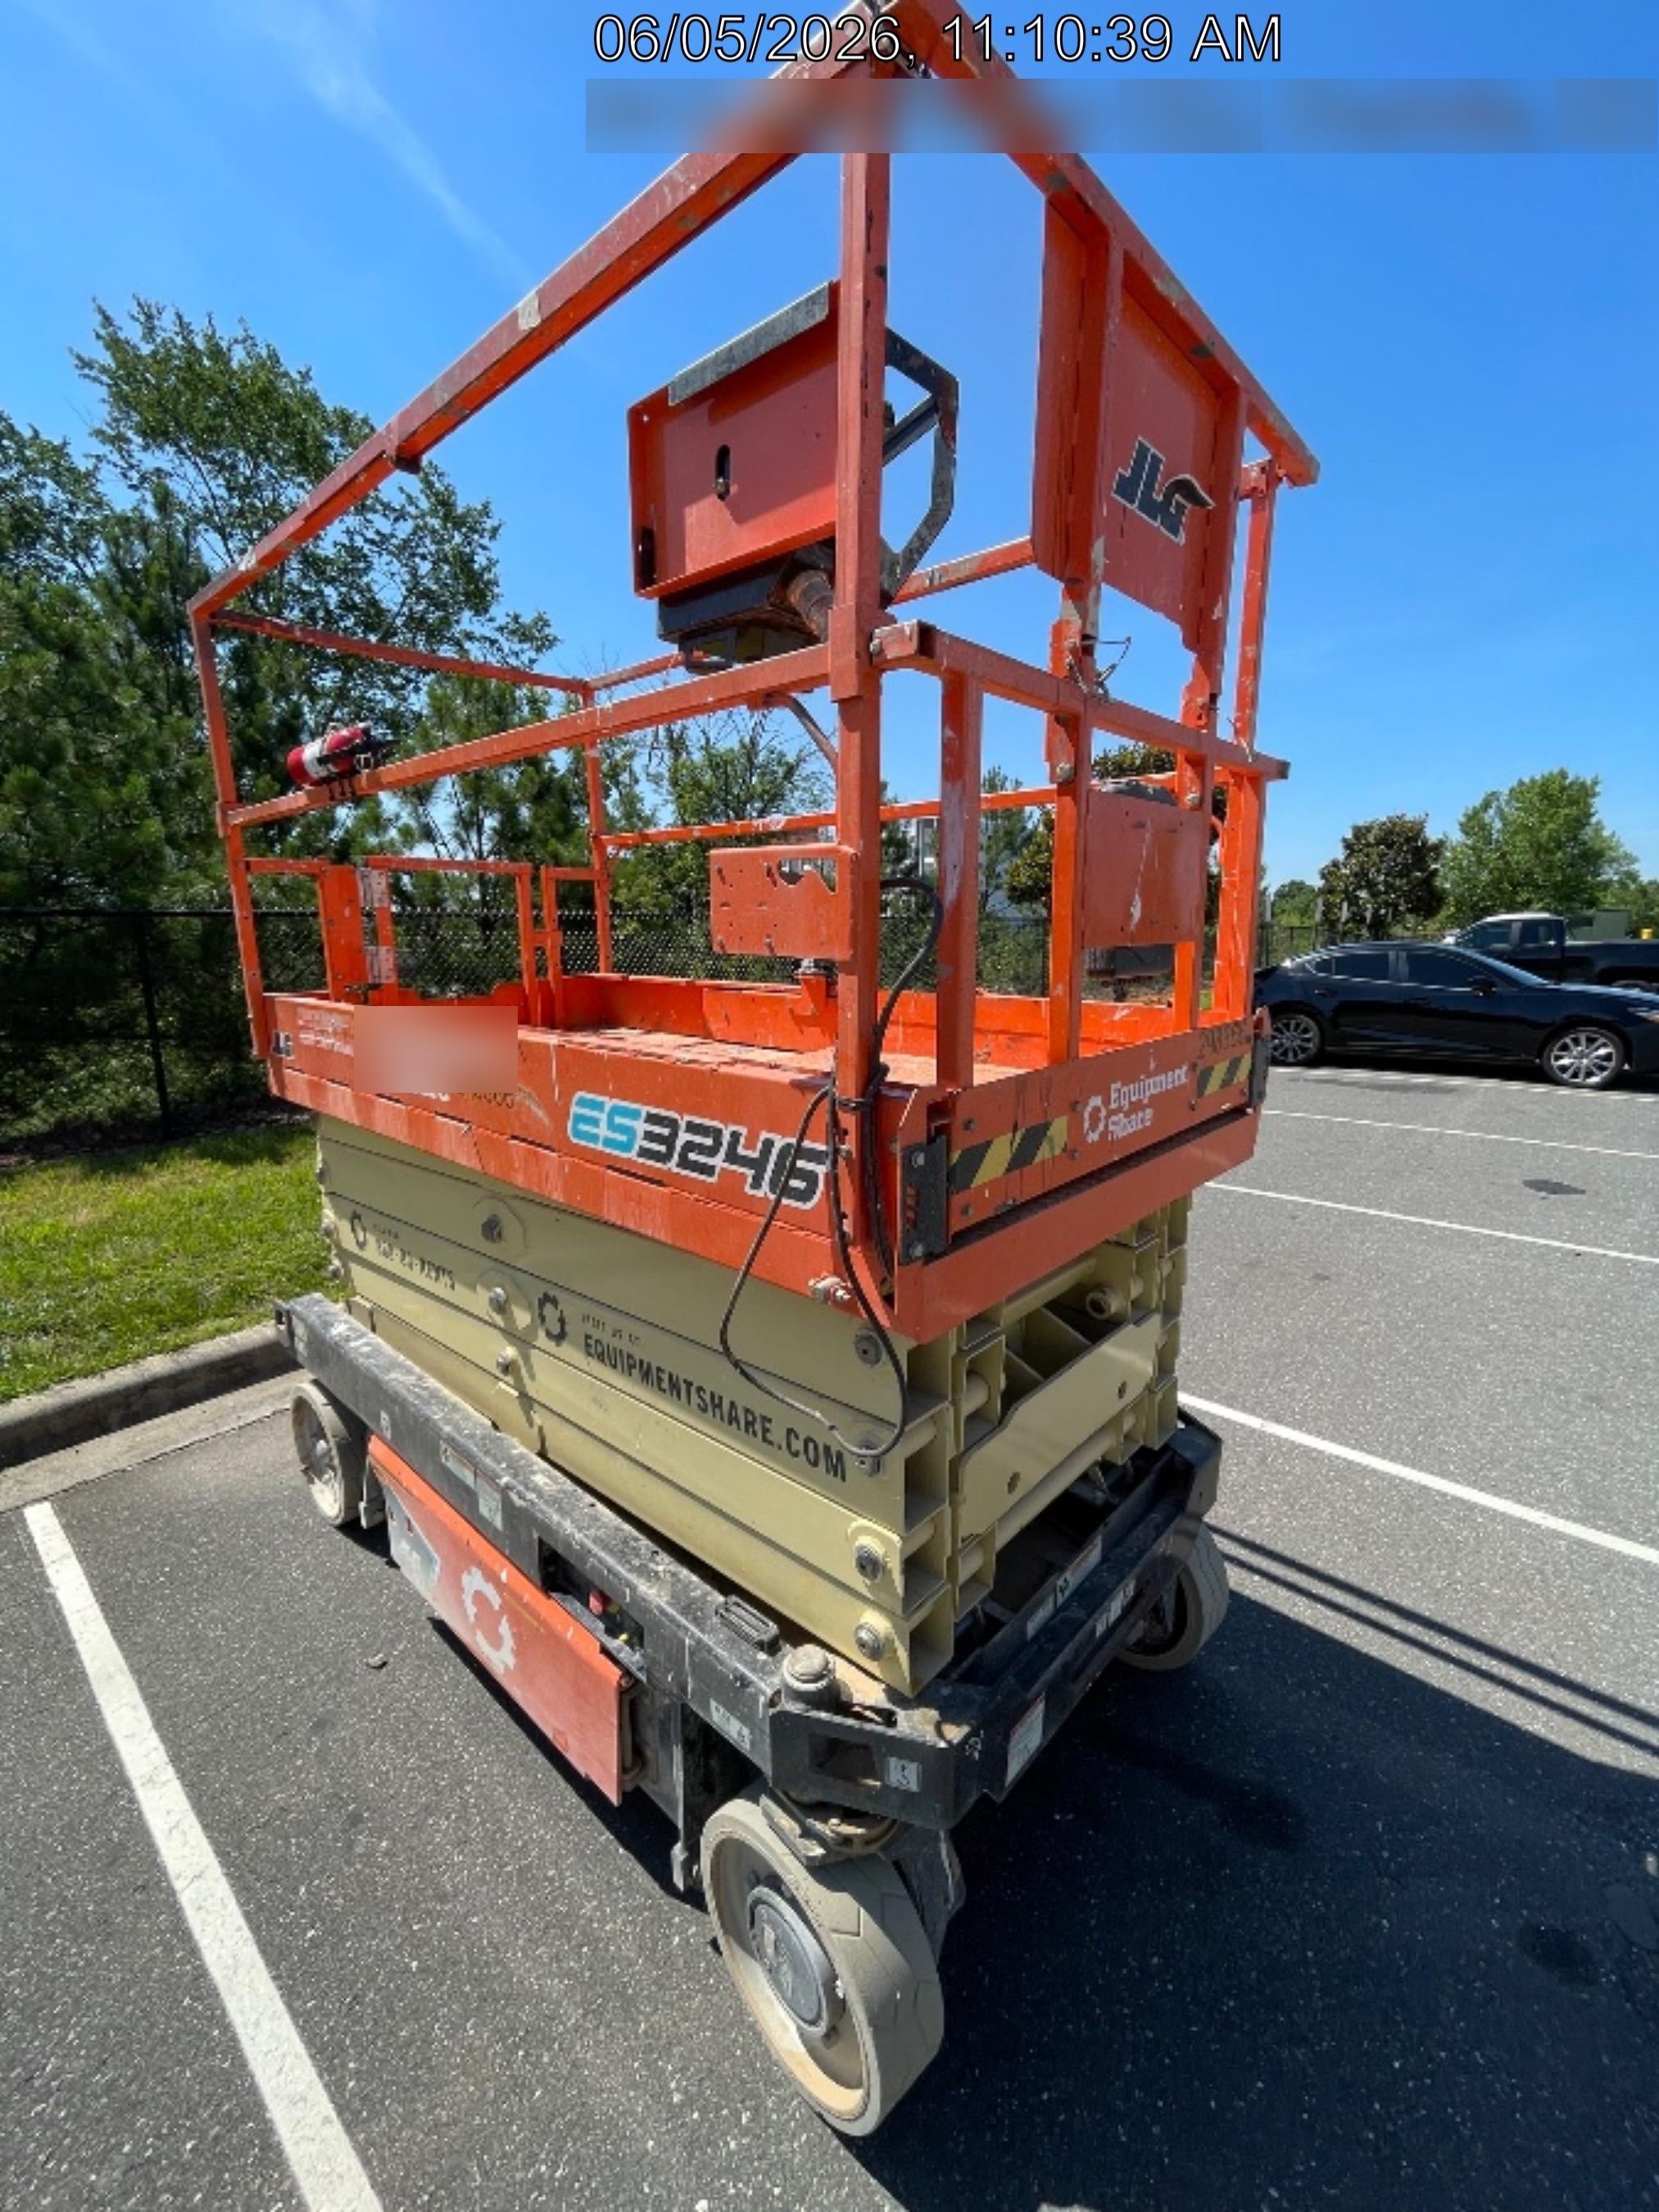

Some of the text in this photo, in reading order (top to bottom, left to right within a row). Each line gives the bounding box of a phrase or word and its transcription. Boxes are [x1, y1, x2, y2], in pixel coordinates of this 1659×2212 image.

[1111, 435, 1216, 546] JLG
[1108, 1063, 1188, 1111] Equipment
[1108, 1108, 1154, 1140] Share
[567, 1090, 830, 1210] ES3246
[584, 1333, 847, 1483] EQUIPMENTSHARE.COM
